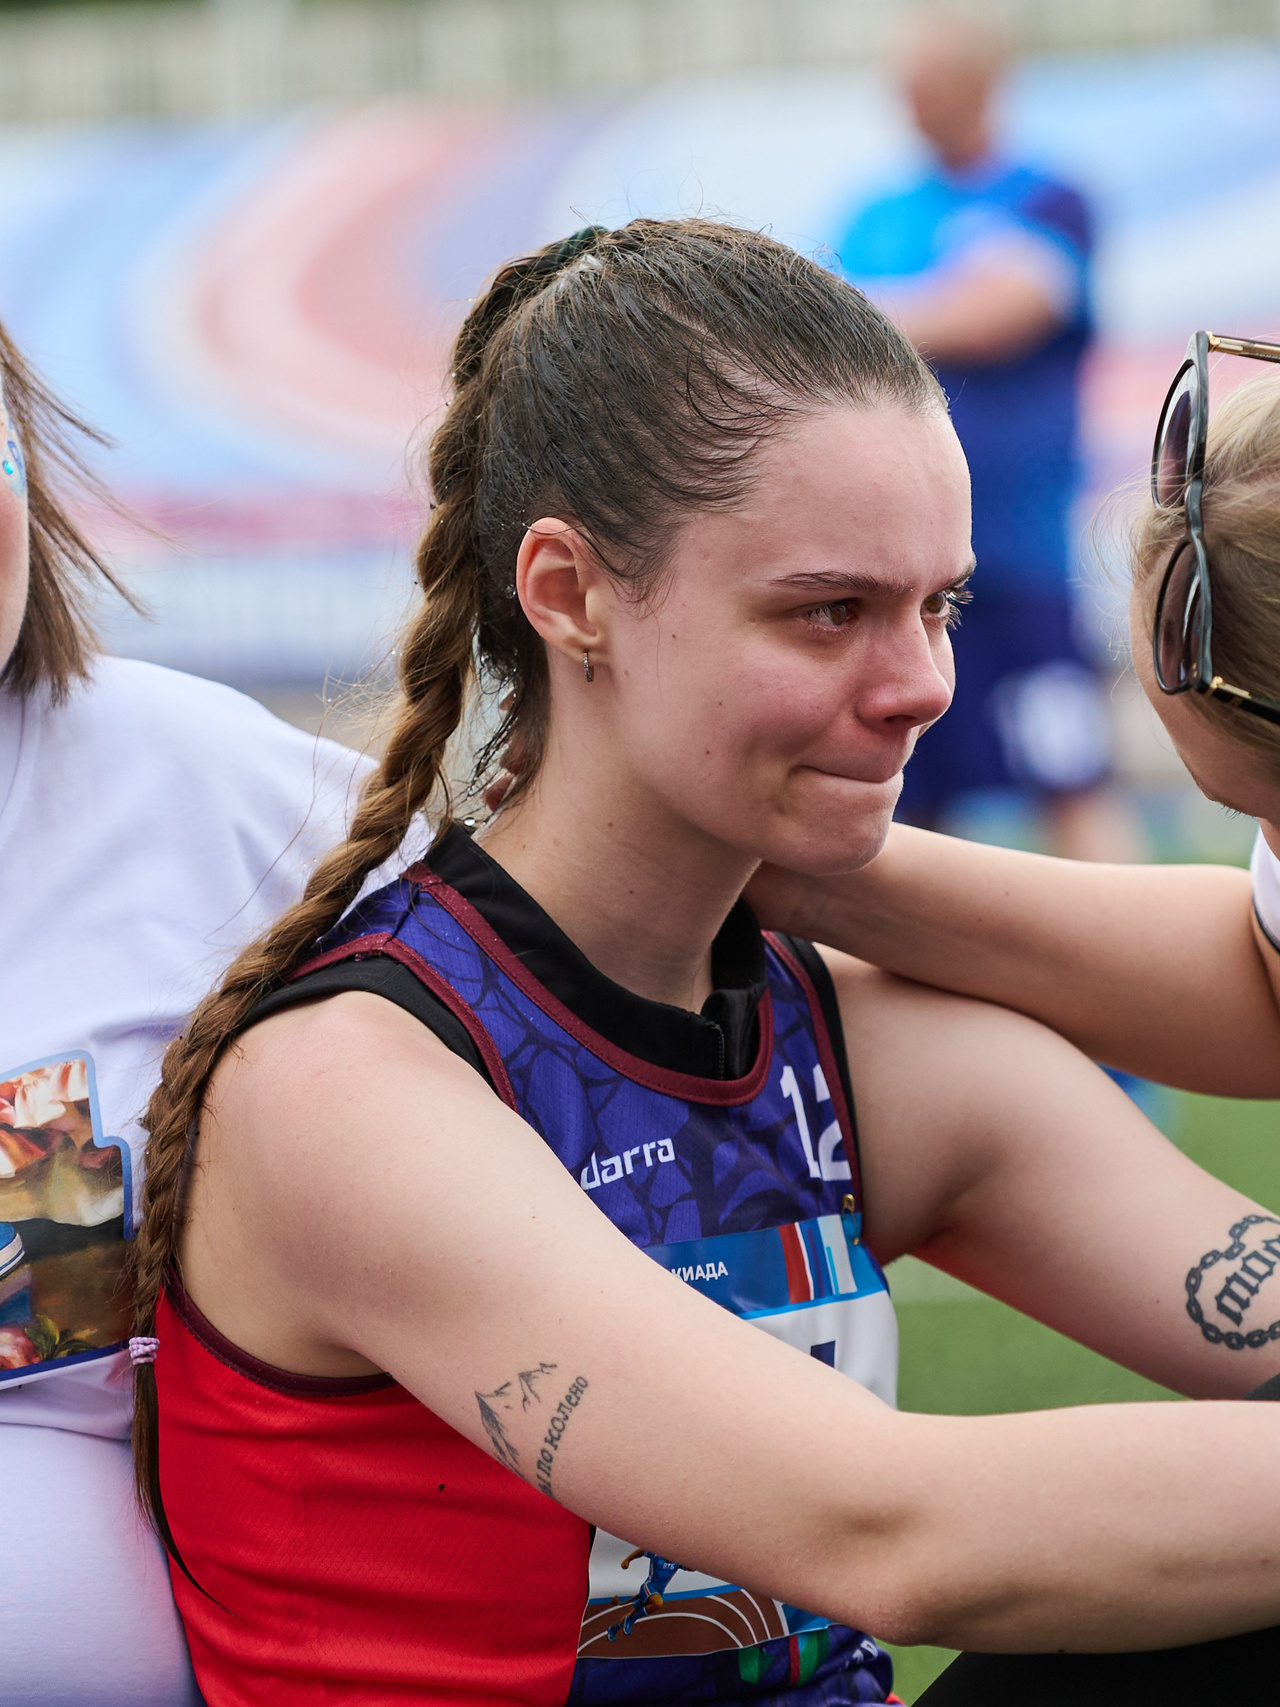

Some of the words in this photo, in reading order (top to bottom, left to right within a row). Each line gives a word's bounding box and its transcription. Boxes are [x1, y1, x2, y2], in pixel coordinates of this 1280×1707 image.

[779, 1063, 853, 1182] 12
[543, 1375, 589, 1451] колено
[536, 1448, 554, 1478] по
